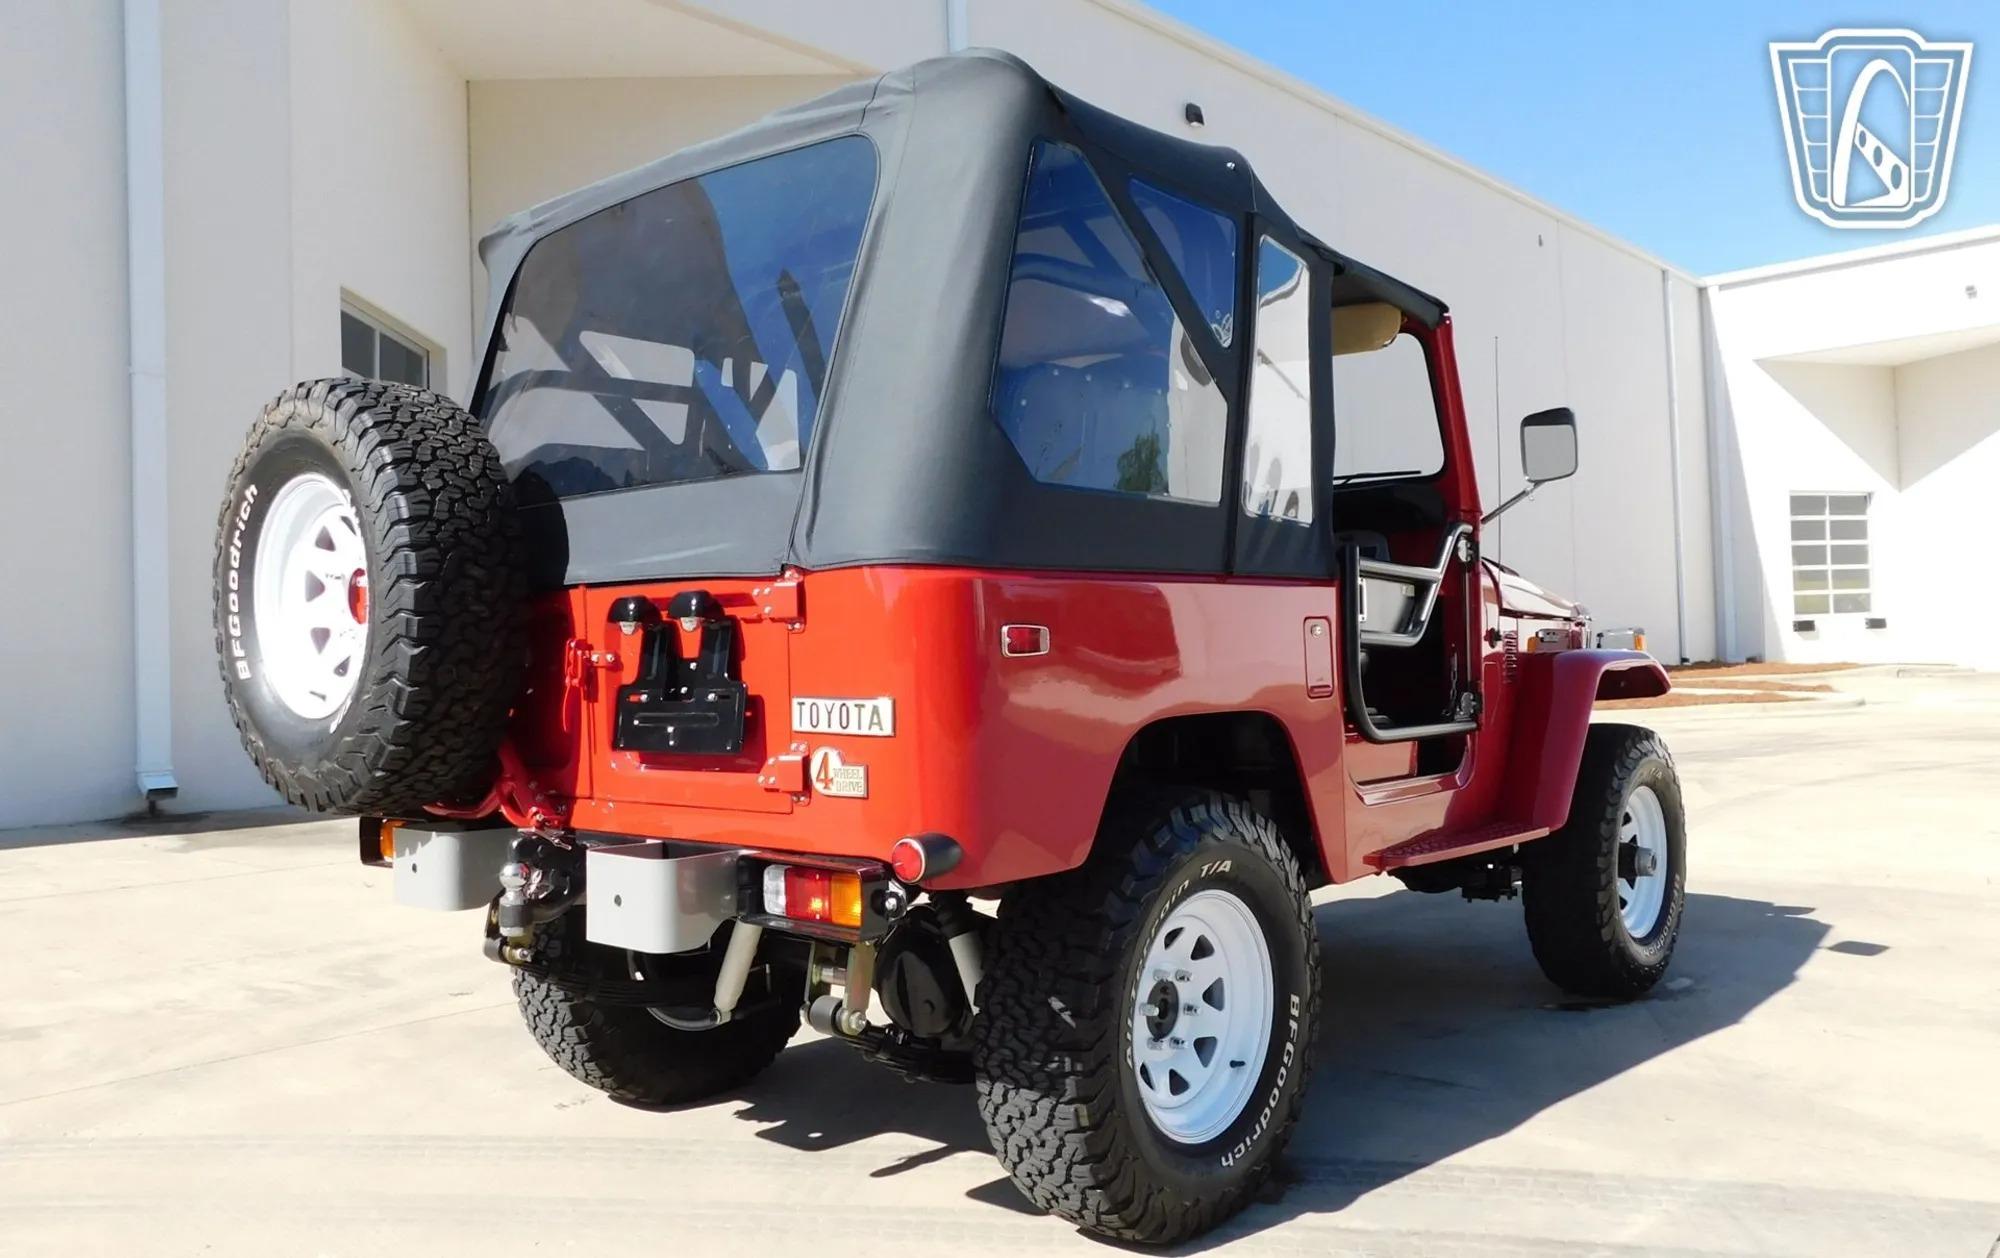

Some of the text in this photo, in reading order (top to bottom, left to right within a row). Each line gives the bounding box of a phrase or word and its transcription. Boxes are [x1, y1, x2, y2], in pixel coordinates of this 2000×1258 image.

[228, 484, 258, 680] BFGoodrich
[797, 701, 884, 731] TOYOTA
[816, 751, 834, 791] 4
[836, 780, 863, 793] DRIVE
[1201, 860, 1232, 878] T/A
[1220, 992, 1301, 1169] BFGoodrich
